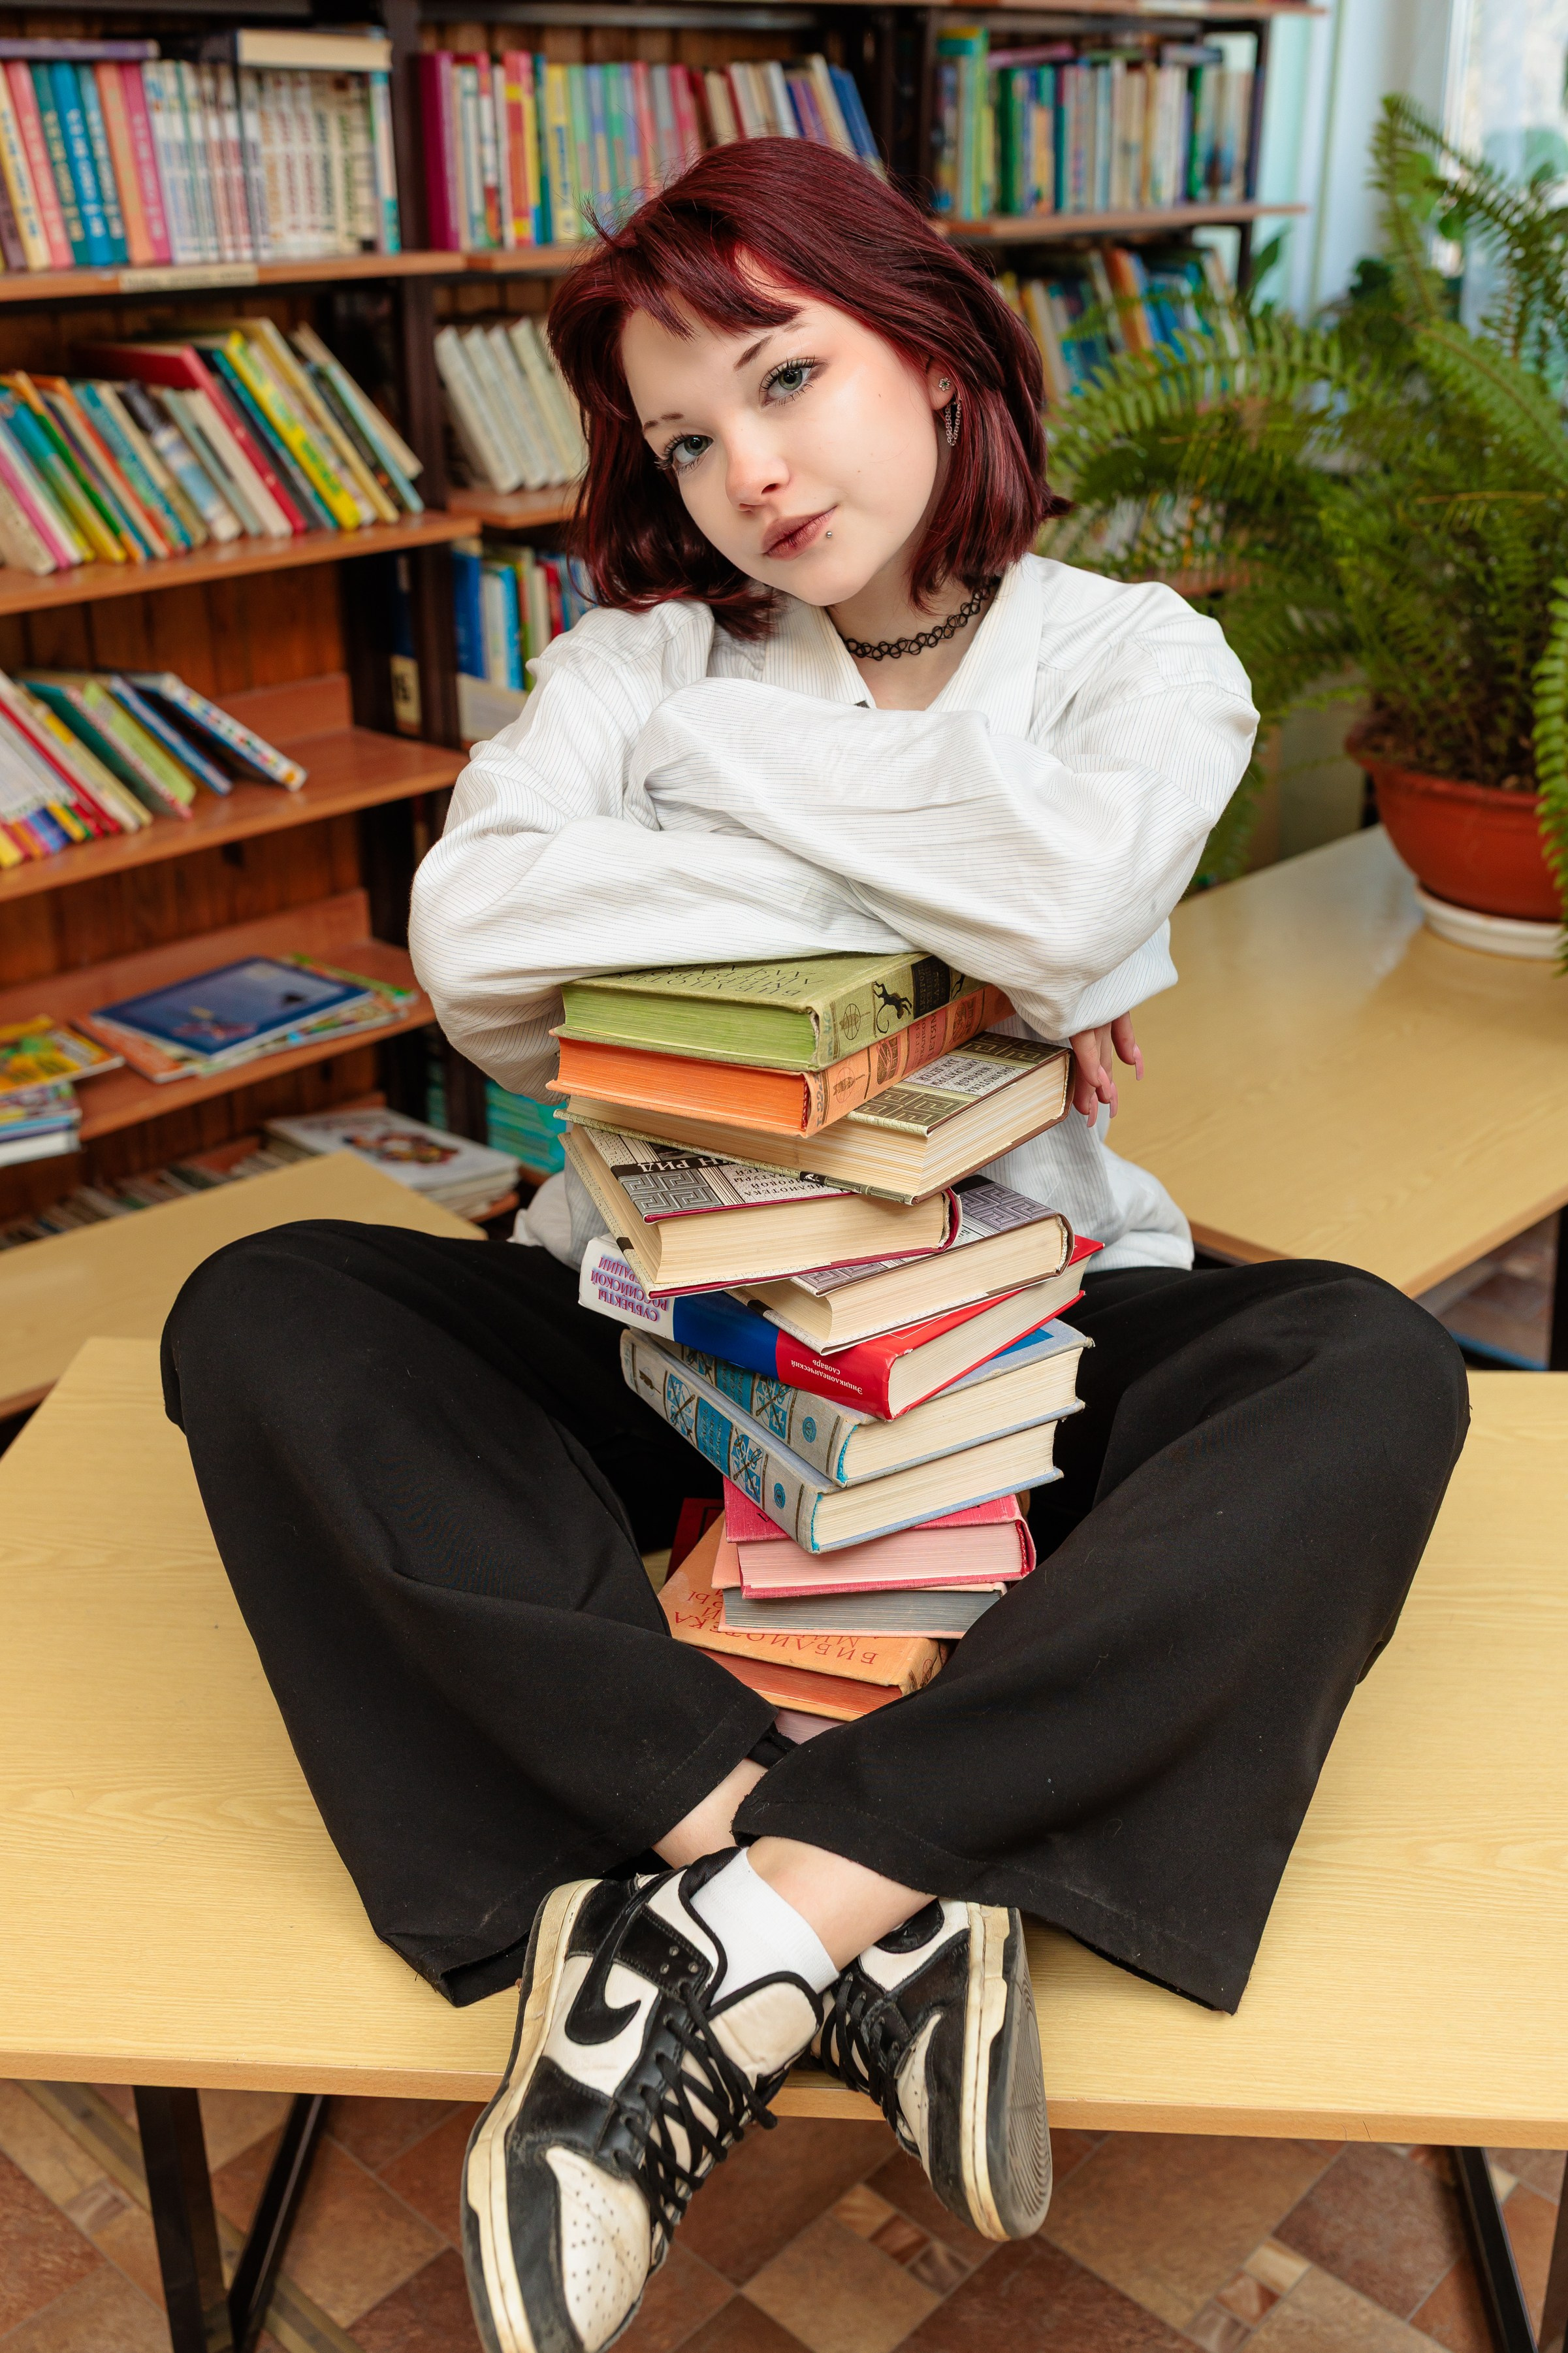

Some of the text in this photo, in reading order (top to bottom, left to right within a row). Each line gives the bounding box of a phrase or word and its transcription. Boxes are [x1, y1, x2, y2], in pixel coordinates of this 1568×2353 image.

[609, 972, 801, 996] БИБЛИОТЕК
[918, 1058, 959, 1082] ДЛЯ ДЕТЕЙ
[930, 1060, 981, 1086] ЛИТЕРАТУРЫ
[954, 1066, 993, 1086] МИРОВОЙ
[965, 1067, 1016, 1092] БИБЛИОТЕКА
[637, 1160, 690, 1173] РИД
[744, 1184, 825, 1197] ИБЛИОТЕКА
[751, 1178, 804, 1189] ИРОВОЙ
[598, 1288, 658, 1322] СУБЪЕКТЫ
[791, 1360, 863, 1395] Энциклопедический
[812, 1359, 840, 1375] словарь
